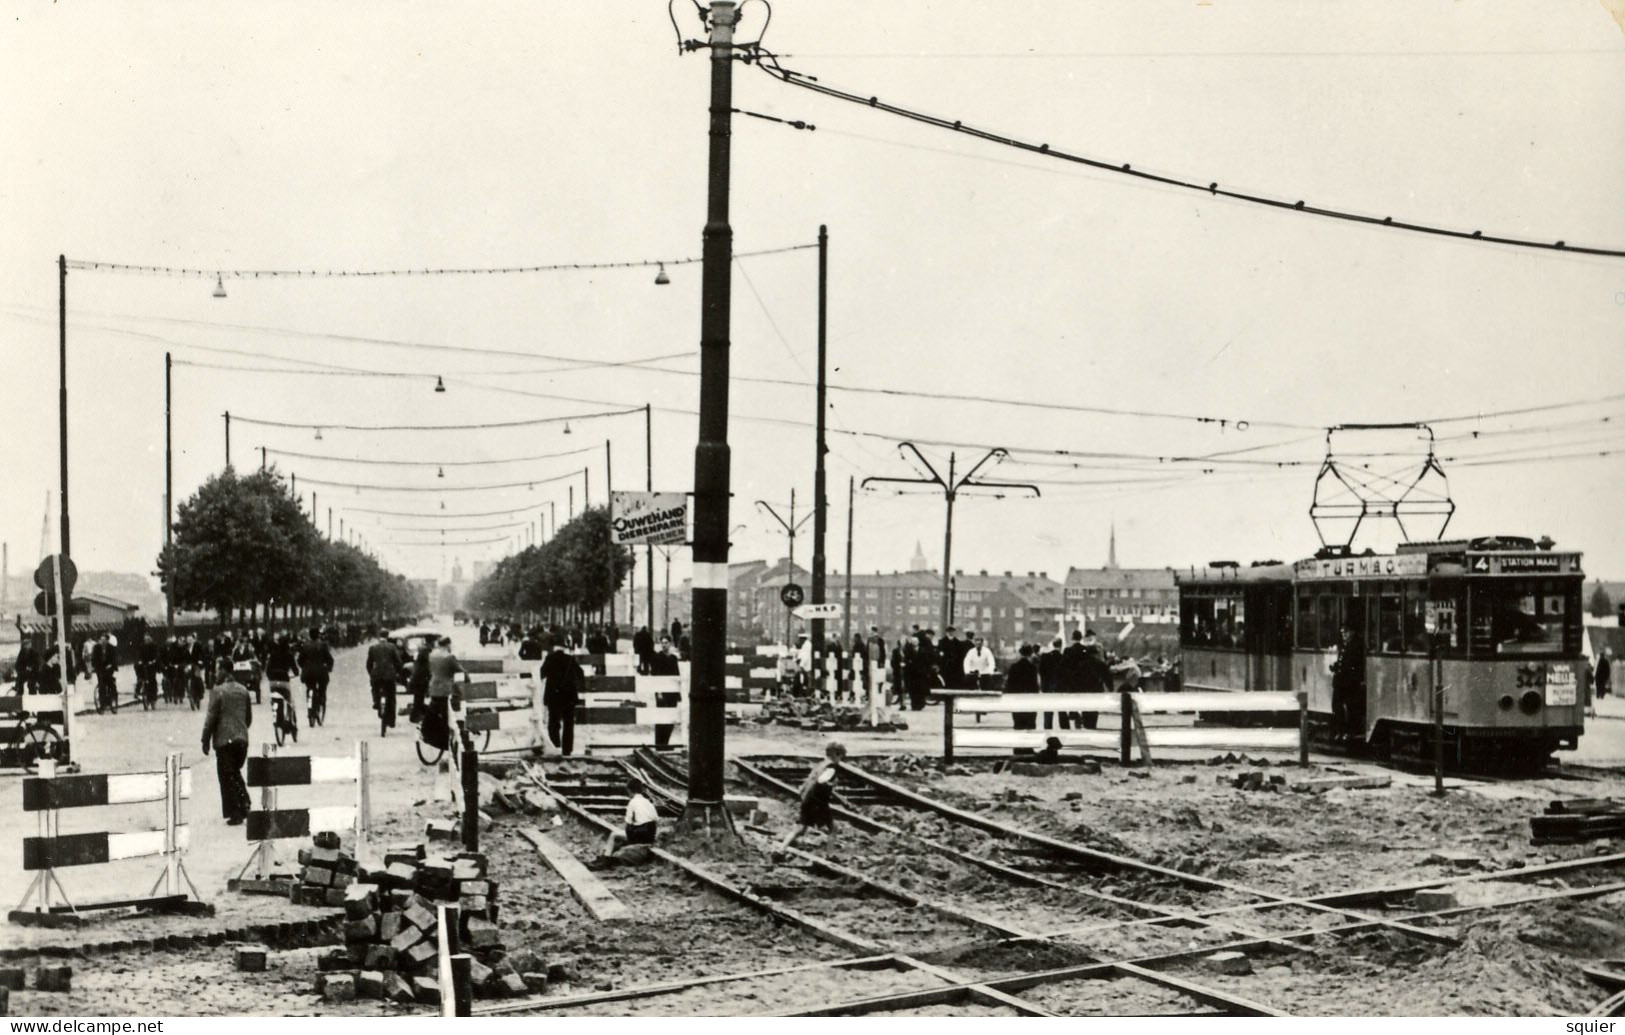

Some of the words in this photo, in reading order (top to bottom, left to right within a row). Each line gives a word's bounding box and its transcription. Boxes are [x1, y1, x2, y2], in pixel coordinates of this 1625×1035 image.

[618, 518, 685, 541] DIERENPARK
[1475, 556, 1489, 570] 4
[1502, 557, 1534, 567] STATION
